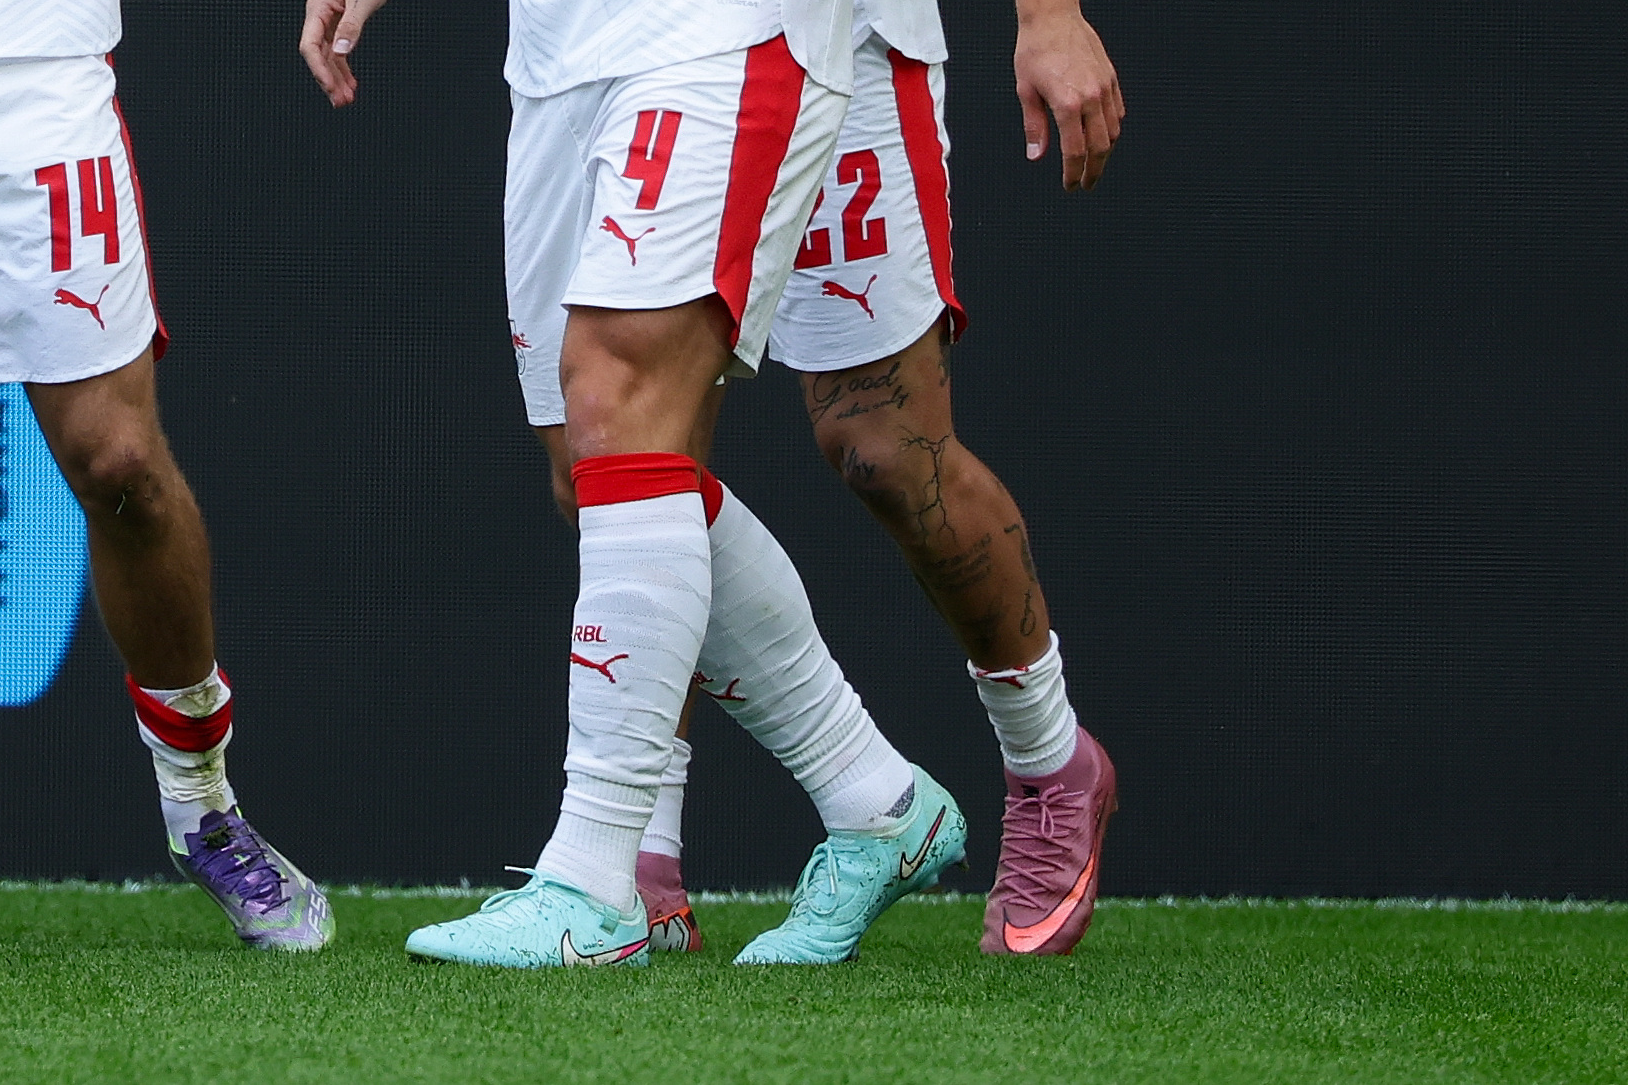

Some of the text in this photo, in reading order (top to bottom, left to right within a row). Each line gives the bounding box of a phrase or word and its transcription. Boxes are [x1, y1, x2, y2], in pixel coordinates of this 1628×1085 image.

[34, 155, 122, 273] 14
[620, 109, 683, 211] 4
[793, 148, 889, 271] 22
[573, 625, 607, 643] RBL
